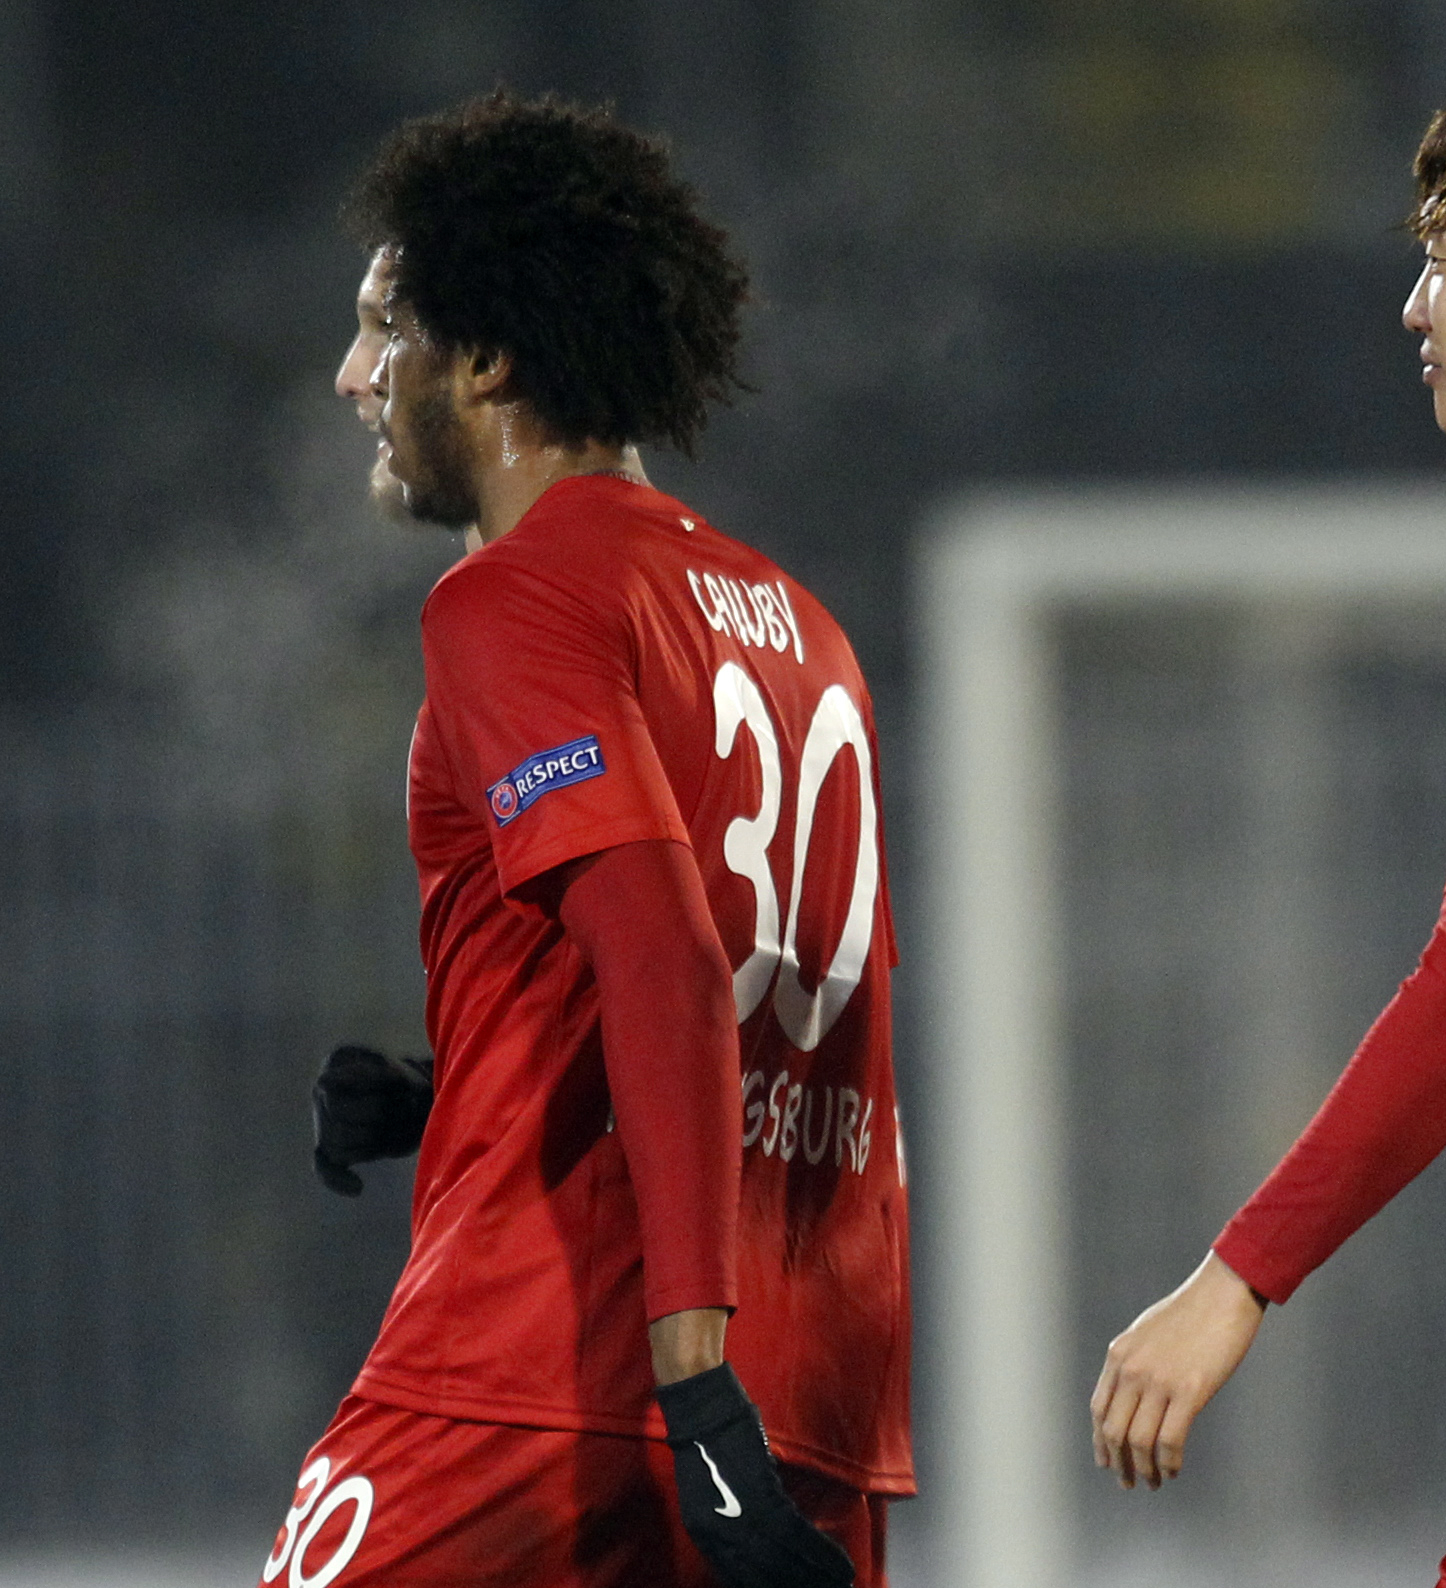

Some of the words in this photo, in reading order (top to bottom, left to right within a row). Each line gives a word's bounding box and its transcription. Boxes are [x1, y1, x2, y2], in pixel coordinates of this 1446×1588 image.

[686, 568, 804, 665] CAIUBY
[515, 745, 599, 798] RESPECT
[712, 661, 878, 1053] 30
[741, 1069, 873, 1176] GSBURG
